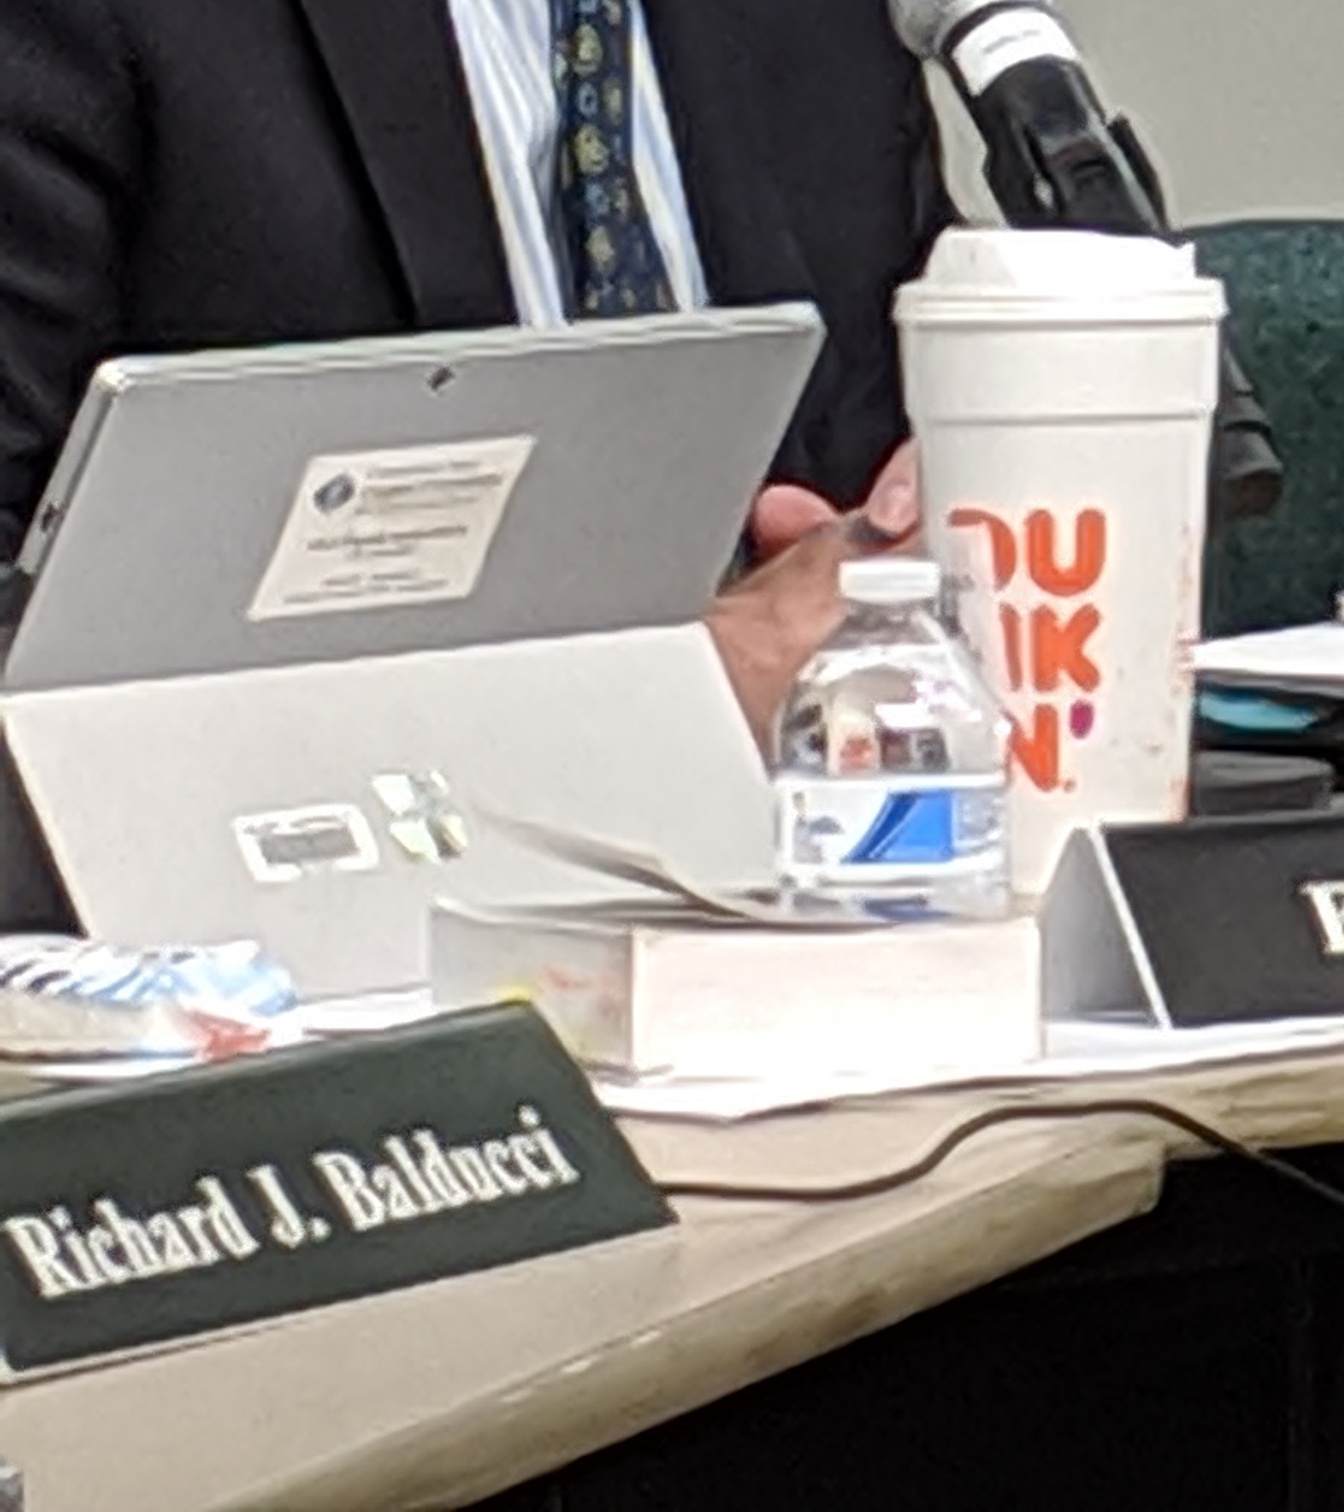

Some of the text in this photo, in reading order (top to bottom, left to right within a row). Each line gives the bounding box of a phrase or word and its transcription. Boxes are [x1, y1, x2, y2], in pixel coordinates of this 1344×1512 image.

[3, 1105, 580, 1299] Richard J. Balducci
